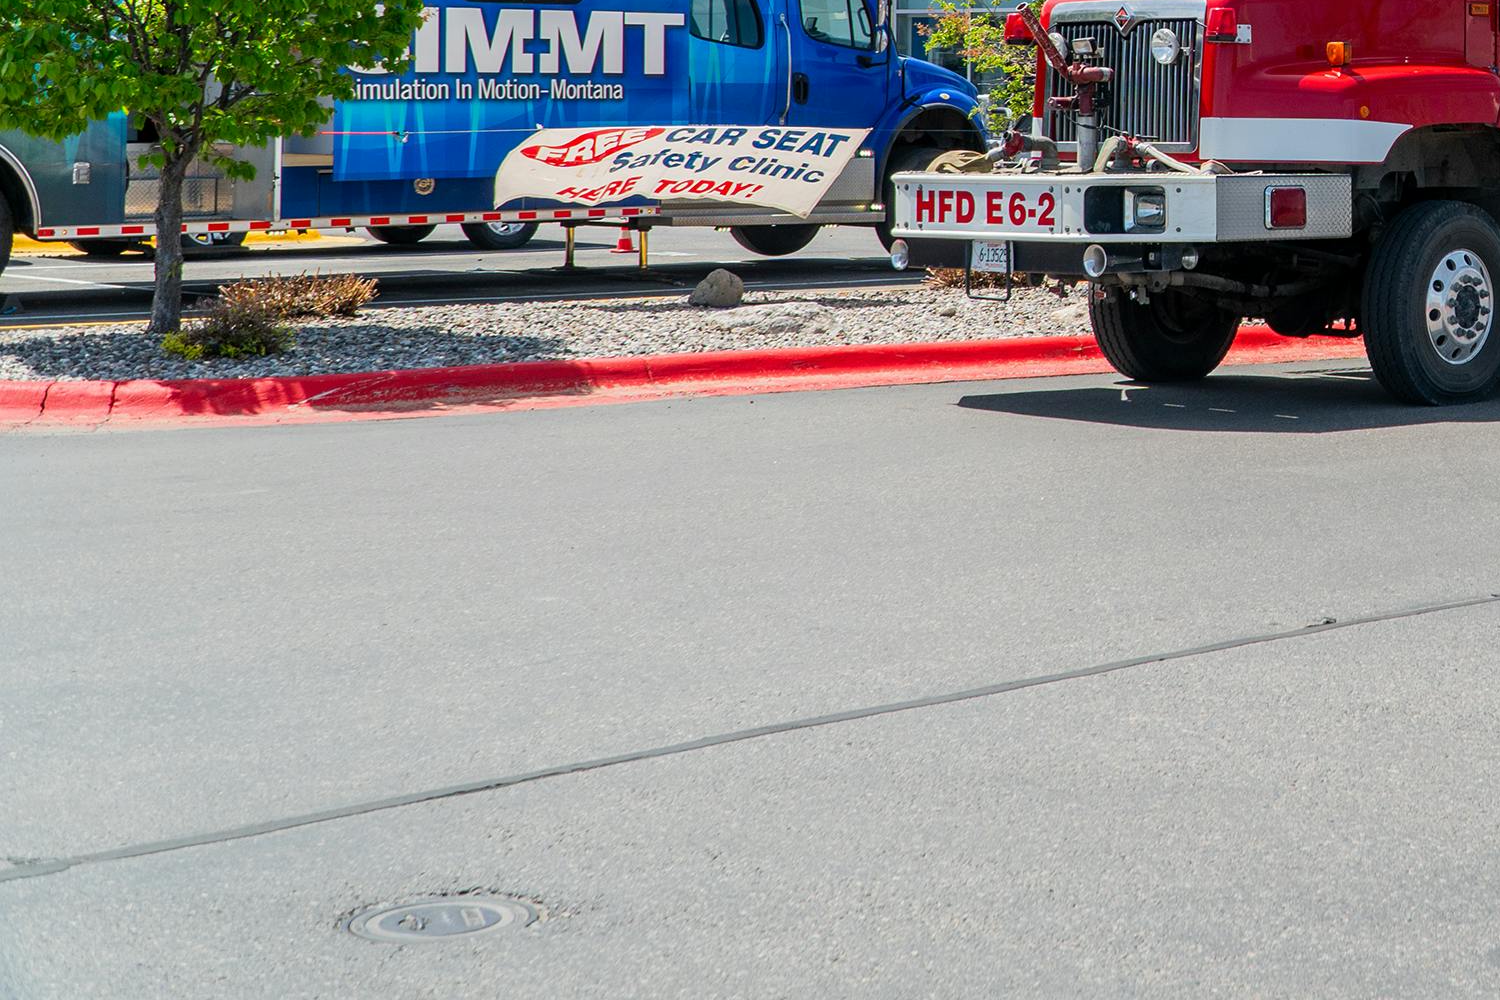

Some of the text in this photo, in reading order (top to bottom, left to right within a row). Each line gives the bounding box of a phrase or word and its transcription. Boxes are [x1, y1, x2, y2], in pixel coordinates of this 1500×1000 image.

[353, 78, 449, 100] imulation
[455, 78, 472, 100] In
[535, 127, 851, 163] FREE CAR SEAT
[609, 148, 825, 184] Safety Clinic
[556, 176, 765, 201] HERE TODAY!
[915, 190, 976, 224] HFD
